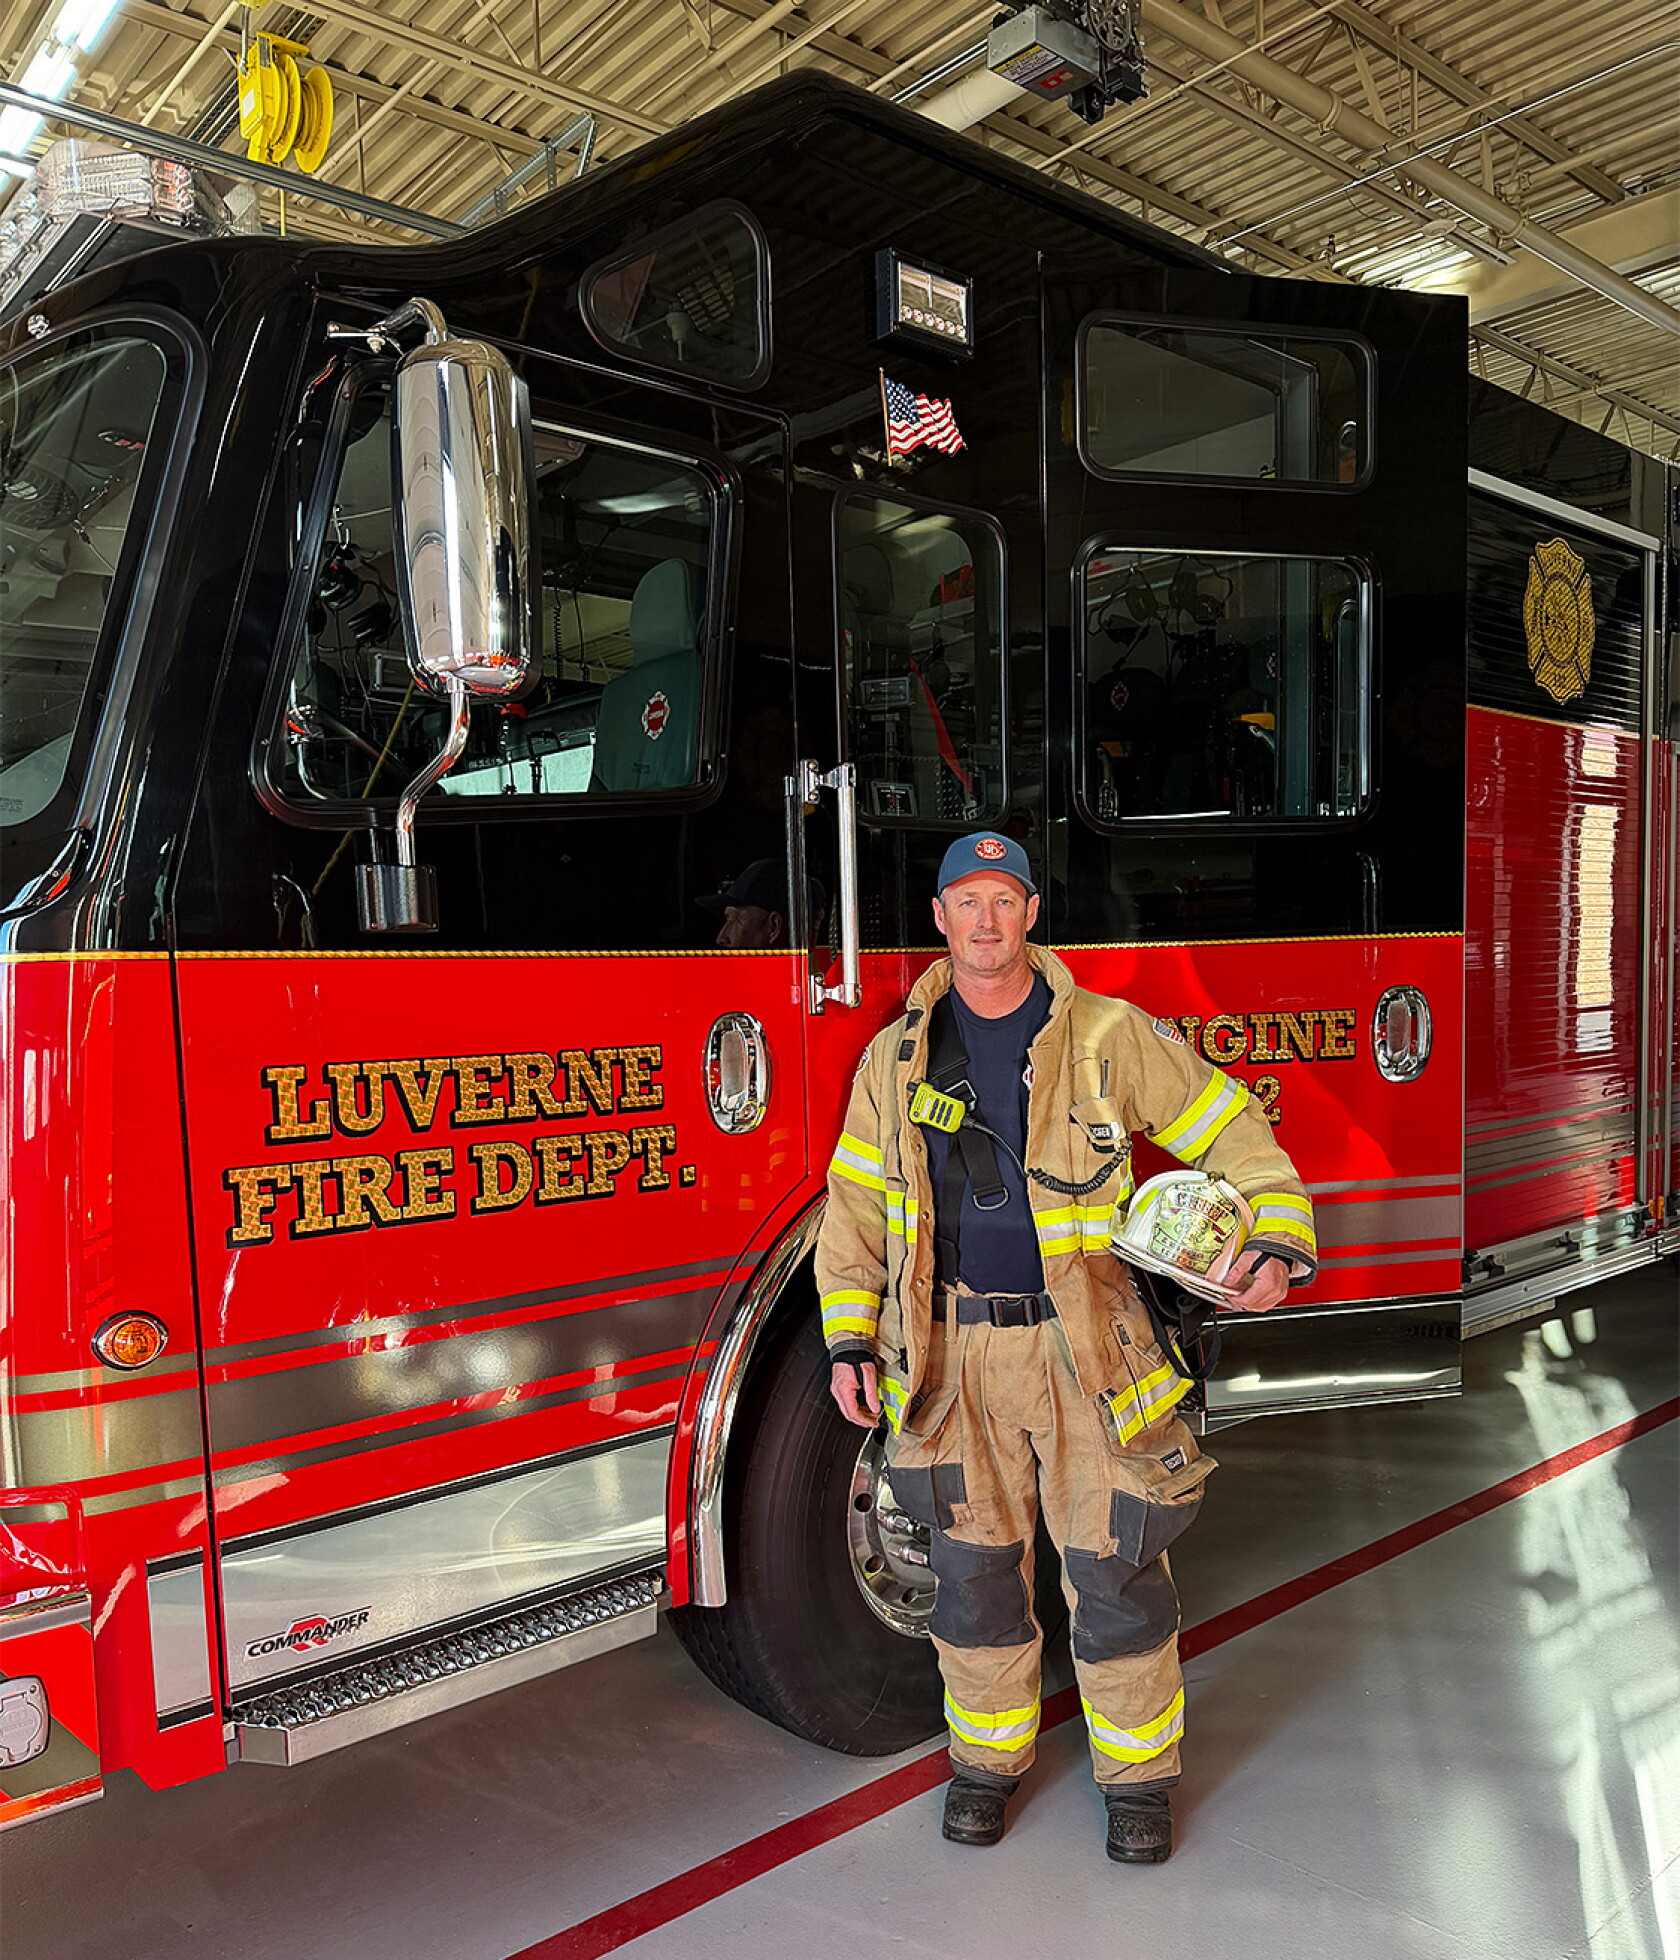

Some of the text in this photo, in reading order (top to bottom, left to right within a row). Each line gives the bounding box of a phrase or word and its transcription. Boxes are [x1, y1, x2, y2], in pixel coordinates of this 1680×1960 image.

[261, 1045, 663, 1146] LUVERNE
[225, 1124, 697, 1249] FIRE DEPT.
[247, 1611, 369, 1658] COMMANDER
